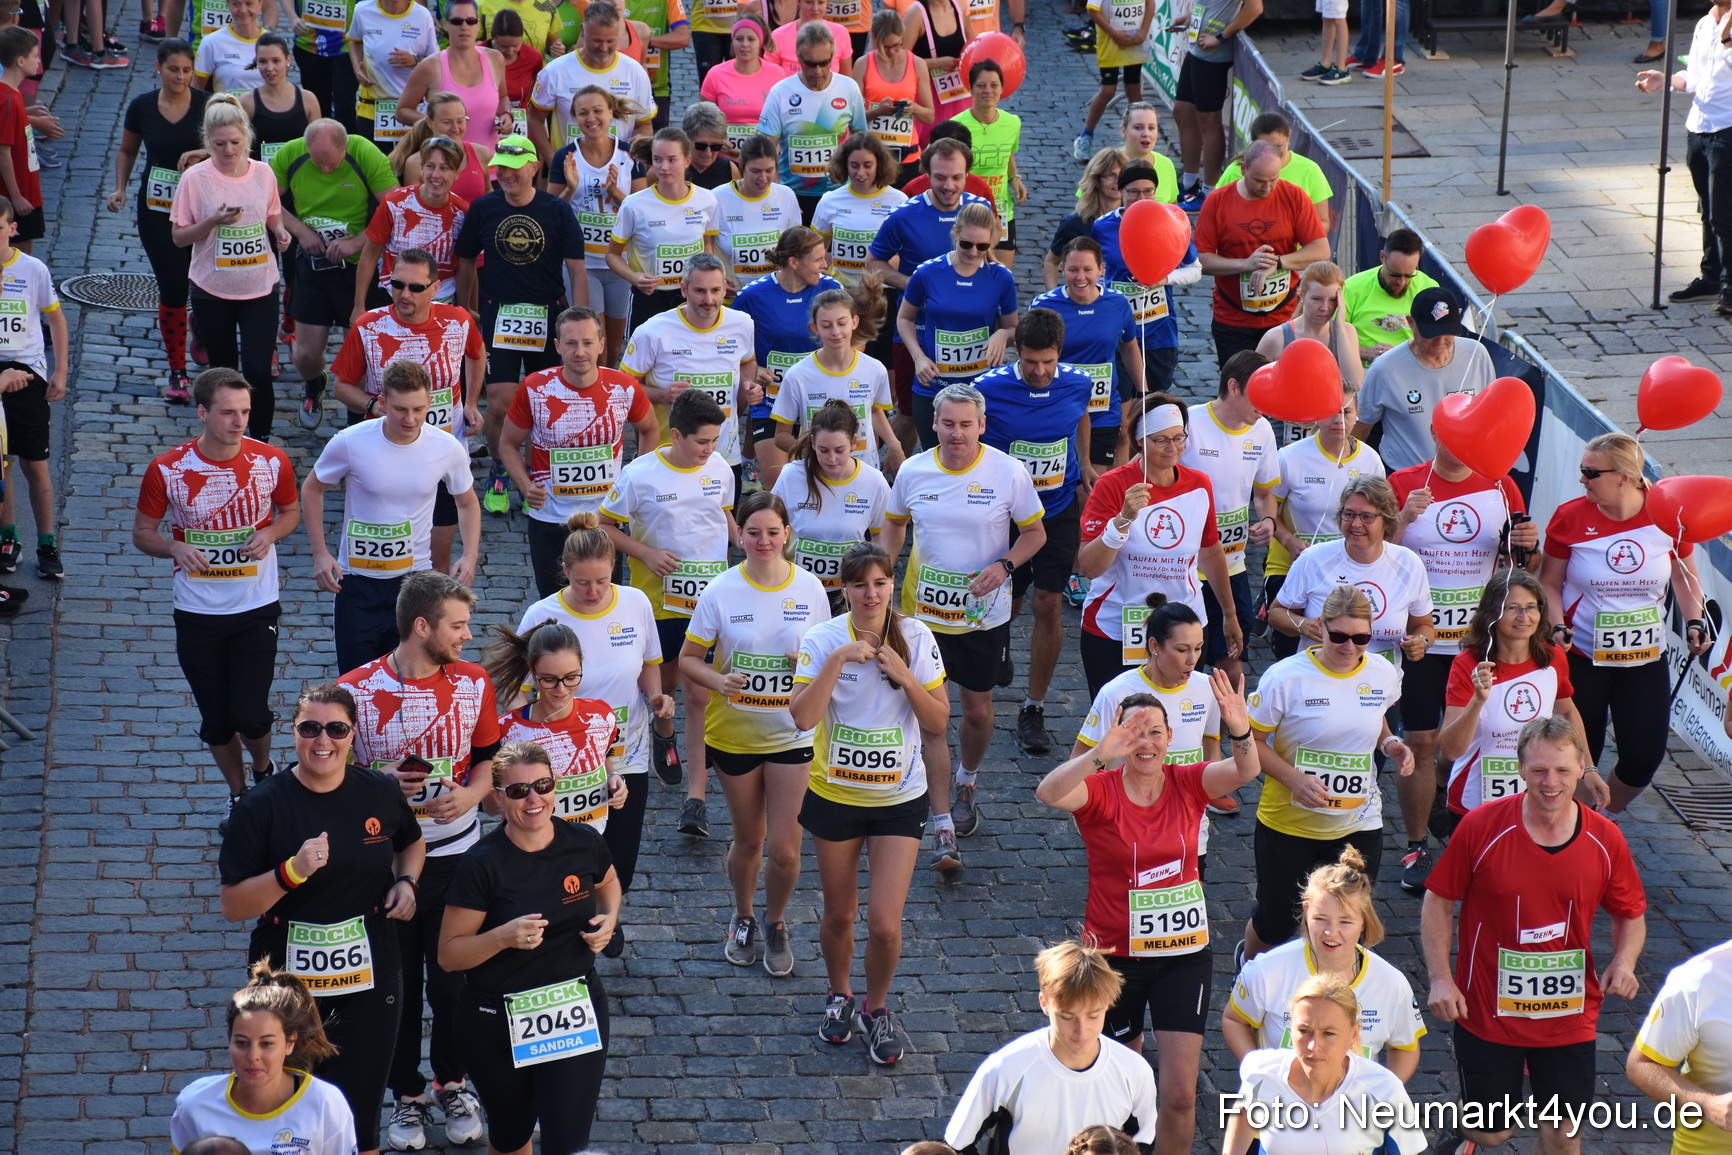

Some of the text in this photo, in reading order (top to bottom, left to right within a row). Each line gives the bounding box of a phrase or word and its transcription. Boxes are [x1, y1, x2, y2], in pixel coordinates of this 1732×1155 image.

[306, 4, 341, 17] 5253
[1114, 7, 1143, 18] 4038
[872, 117, 909, 132] 5140
[383, 130, 409, 138] CLAUD
[792, 137, 833, 147] BOCK
[794, 149, 832, 163] 5113
[153, 170, 180, 181] BOC
[220, 227, 264, 238] BOCK
[499, 217, 540, 238] KAMPFSCHWIMMER
[583, 227, 613, 243] 528
[736, 233, 778, 244] BOCK
[221, 241, 263, 256] 5065
[661, 245, 702, 257] BOCK
[837, 244, 866, 258] 519
[230, 258, 257, 266] DARJA
[836, 260, 865, 269] KATHAR
[503, 304, 546, 316] BOCK
[1258, 299, 1278, 308] JENS
[502, 319, 543, 335] 5236
[504, 337, 536, 345] WERNER
[939, 331, 983, 345] BOCK
[941, 345, 984, 362] 5177
[948, 363, 979, 373] HANNA
[1015, 440, 1064, 456] BOCK
[556, 449, 607, 463] BOCK
[557, 464, 607, 483] 5201
[700, 477, 711, 485] 20
[559, 484, 609, 496] MATTHIAS
[968, 484, 980, 493] 20
[845, 495, 856, 503] 20
[353, 524, 407, 537] BOCK
[191, 531, 248, 545] BOCK
[355, 540, 406, 558] 5262
[1419, 548, 1450, 557] LAUFEN
[1472, 549, 1490, 558] HERZ
[1128, 554, 1157, 563] LAUFEN
[803, 557, 839, 575] 503
[1426, 567, 1481, 575] Leistungsdiagnostik
[199, 569, 245, 577] MANUEL
[1133, 571, 1186, 581] Leistungsdiagnostik
[782, 601, 795, 609] 20
[730, 614, 754, 623] BOCK
[1600, 608, 1656, 625] BOCK
[608, 625, 621, 634] 20
[1384, 628, 1402, 636] HERZ
[1602, 628, 1654, 648] 5121
[737, 655, 791, 669] BOCK
[1606, 650, 1651, 661] KERSTIN
[740, 673, 793, 694] 5019
[1357, 686, 1371, 694] 20
[737, 695, 790, 707] JOHANNA
[1689, 668, 1727, 722] neumar
[1181, 702, 1192, 711] 20
[1305, 698, 1331, 707] BOCK
[838, 727, 896, 745] BOCK
[837, 749, 897, 769] 5096
[1300, 751, 1366, 770] BOCK
[835, 770, 896, 783] ELISABETH
[558, 789, 601, 814] 196
[1150, 868, 1170, 880] DEHN
[1137, 887, 1199, 908] BOCK
[1140, 907, 1200, 935] 5190
[294, 924, 360, 944] BOCK
[1533, 929, 1554, 940] DEHN
[1142, 935, 1197, 950] MELANIE
[296, 944, 363, 972] 5066
[1505, 953, 1576, 969] BOCK
[1508, 974, 1576, 996] 5189
[511, 982, 583, 1012] BOCK
[479, 1006, 497, 1014] SPIRO
[1514, 1000, 1569, 1012] THOMAS
[519, 1005, 586, 1040] 2049
[529, 1035, 584, 1056] SANDRA
[275, 1131, 310, 1145] 20 JAHRE
